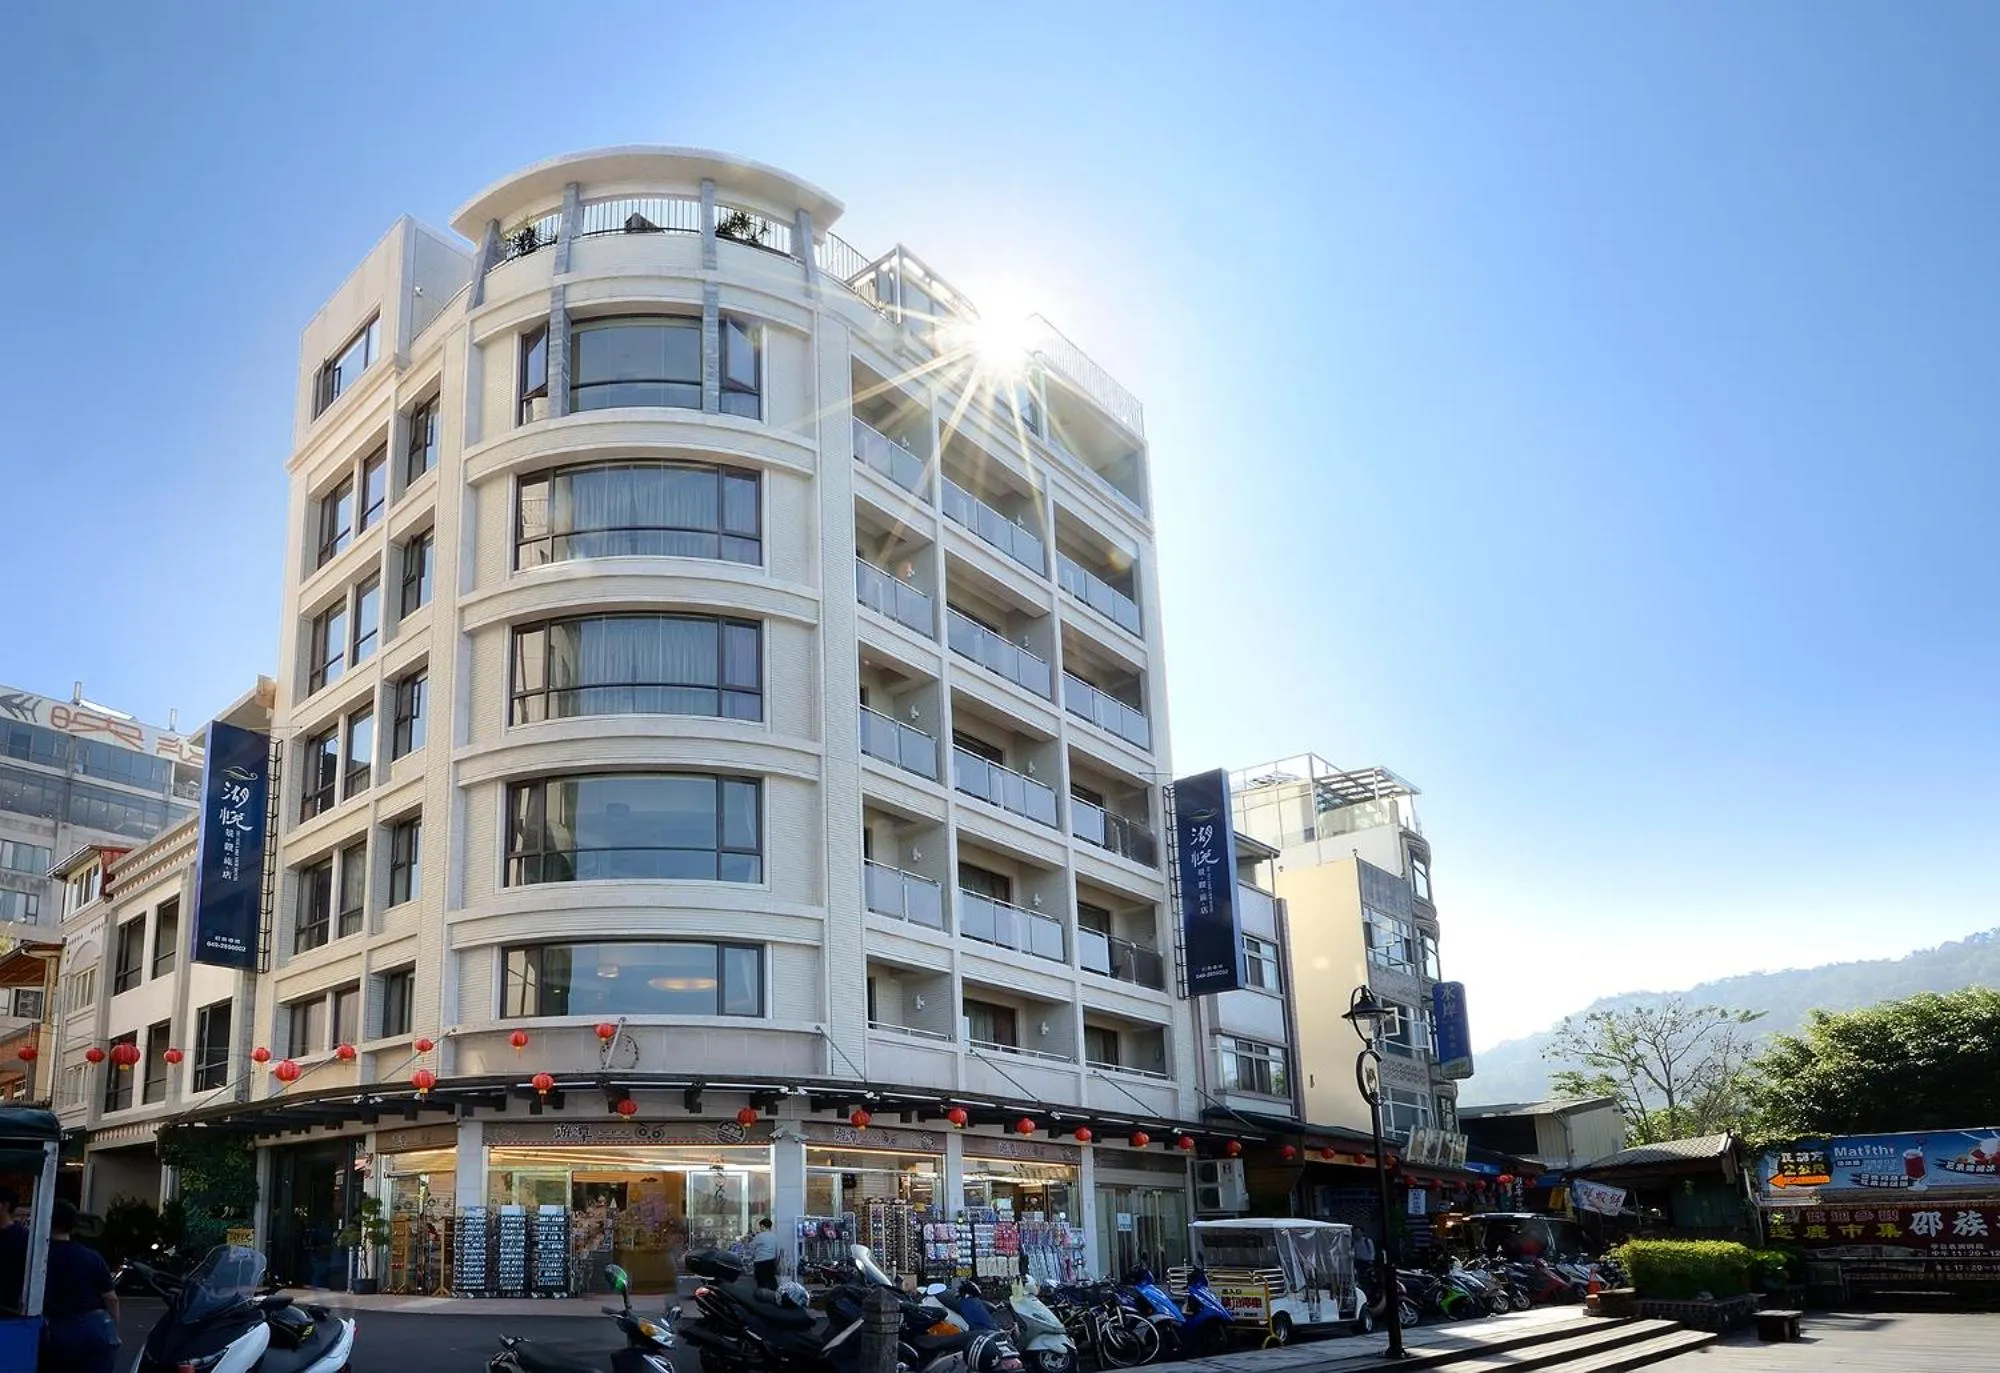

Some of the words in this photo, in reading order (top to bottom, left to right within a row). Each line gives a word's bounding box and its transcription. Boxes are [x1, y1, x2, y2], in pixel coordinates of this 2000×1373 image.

[219, 781, 254, 831] 湖悅
[1190, 824, 1220, 867] 湖悅
[1909, 1210, 2000, 1238] 邵族
